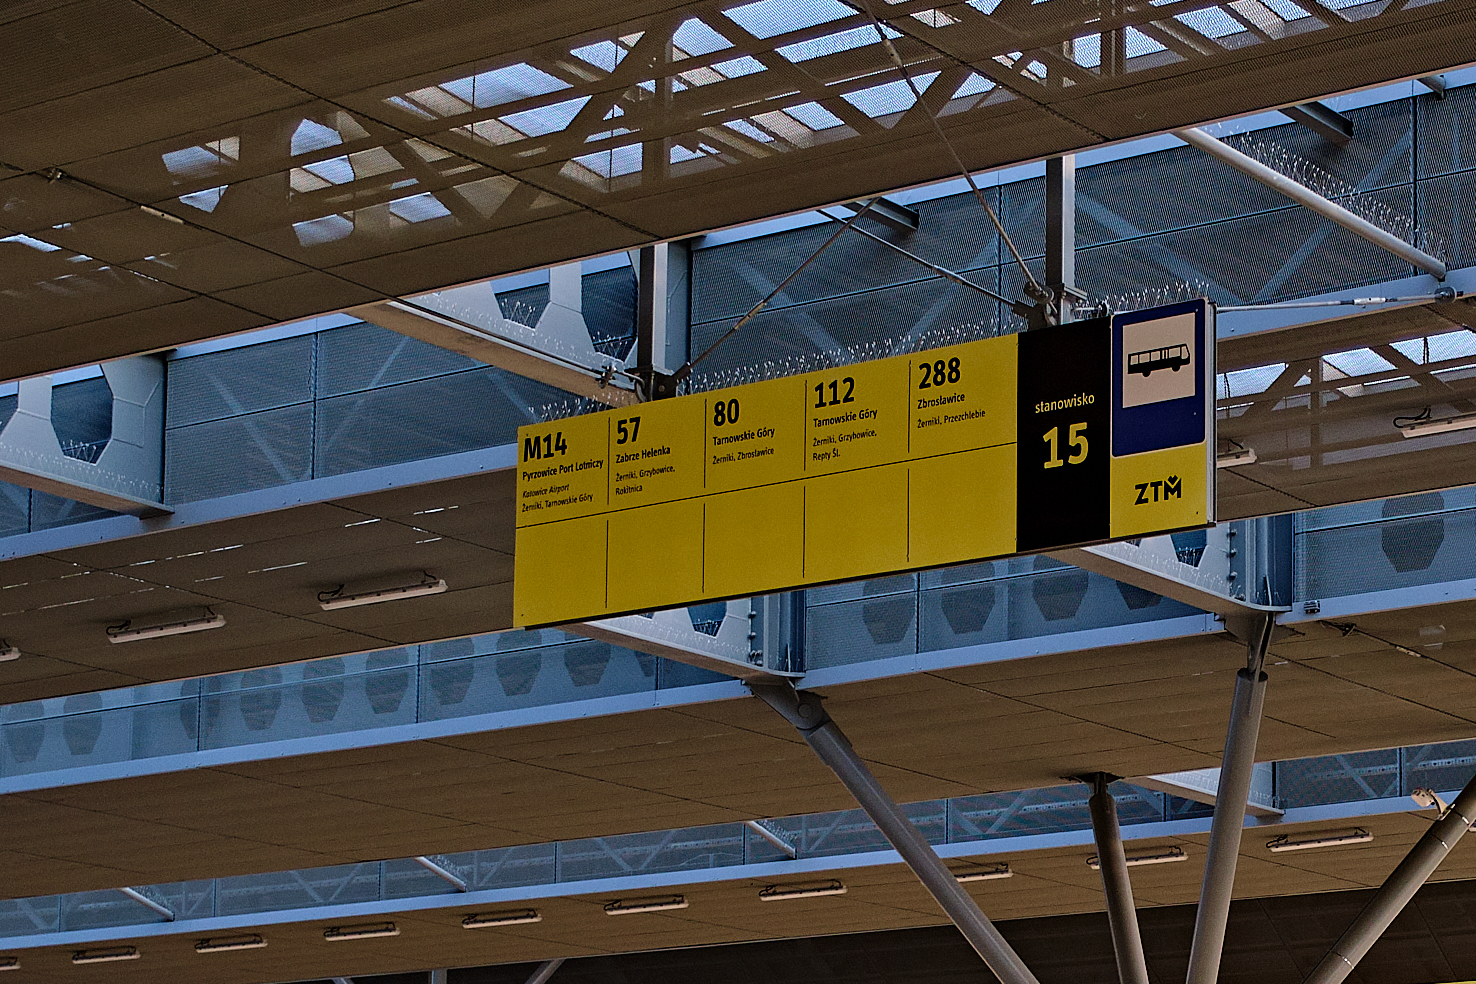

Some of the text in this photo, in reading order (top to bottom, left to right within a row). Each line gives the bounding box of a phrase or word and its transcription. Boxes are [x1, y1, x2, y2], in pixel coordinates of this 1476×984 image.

[918, 357, 961, 390] 288
[814, 377, 854, 408] 112
[917, 392, 966, 409] Zbrosławice
[714, 398, 740, 426] 80
[1034, 392, 1095, 414] stanowisko
[813, 408, 878, 428] Tarnowskie Góry
[917, 410, 986, 429] Żerniki, Przezchlebie
[617, 416, 641, 444] 57
[713, 427, 776, 446] Tarnowskie Góry
[812, 429, 877, 447] Żerniki, Grzybowice,
[524, 432, 567, 462] M14
[616, 446, 670, 464] Zabrze Helenka
[712, 446, 774, 464] Żerniki, Zbrosławice
[1042, 422, 1089, 469] 15
[522, 459, 604, 482] Pyrzowice Port Lotniczy
[640, 465, 676, 478] Grzybowice,
[523, 484, 570, 498] Katowice Airport
[616, 484, 642, 495] Rokitnica
[1134, 474, 1182, 506] ZTM
[545, 496, 577, 508] Tarnowskie
[579, 493, 594, 502] Góry
